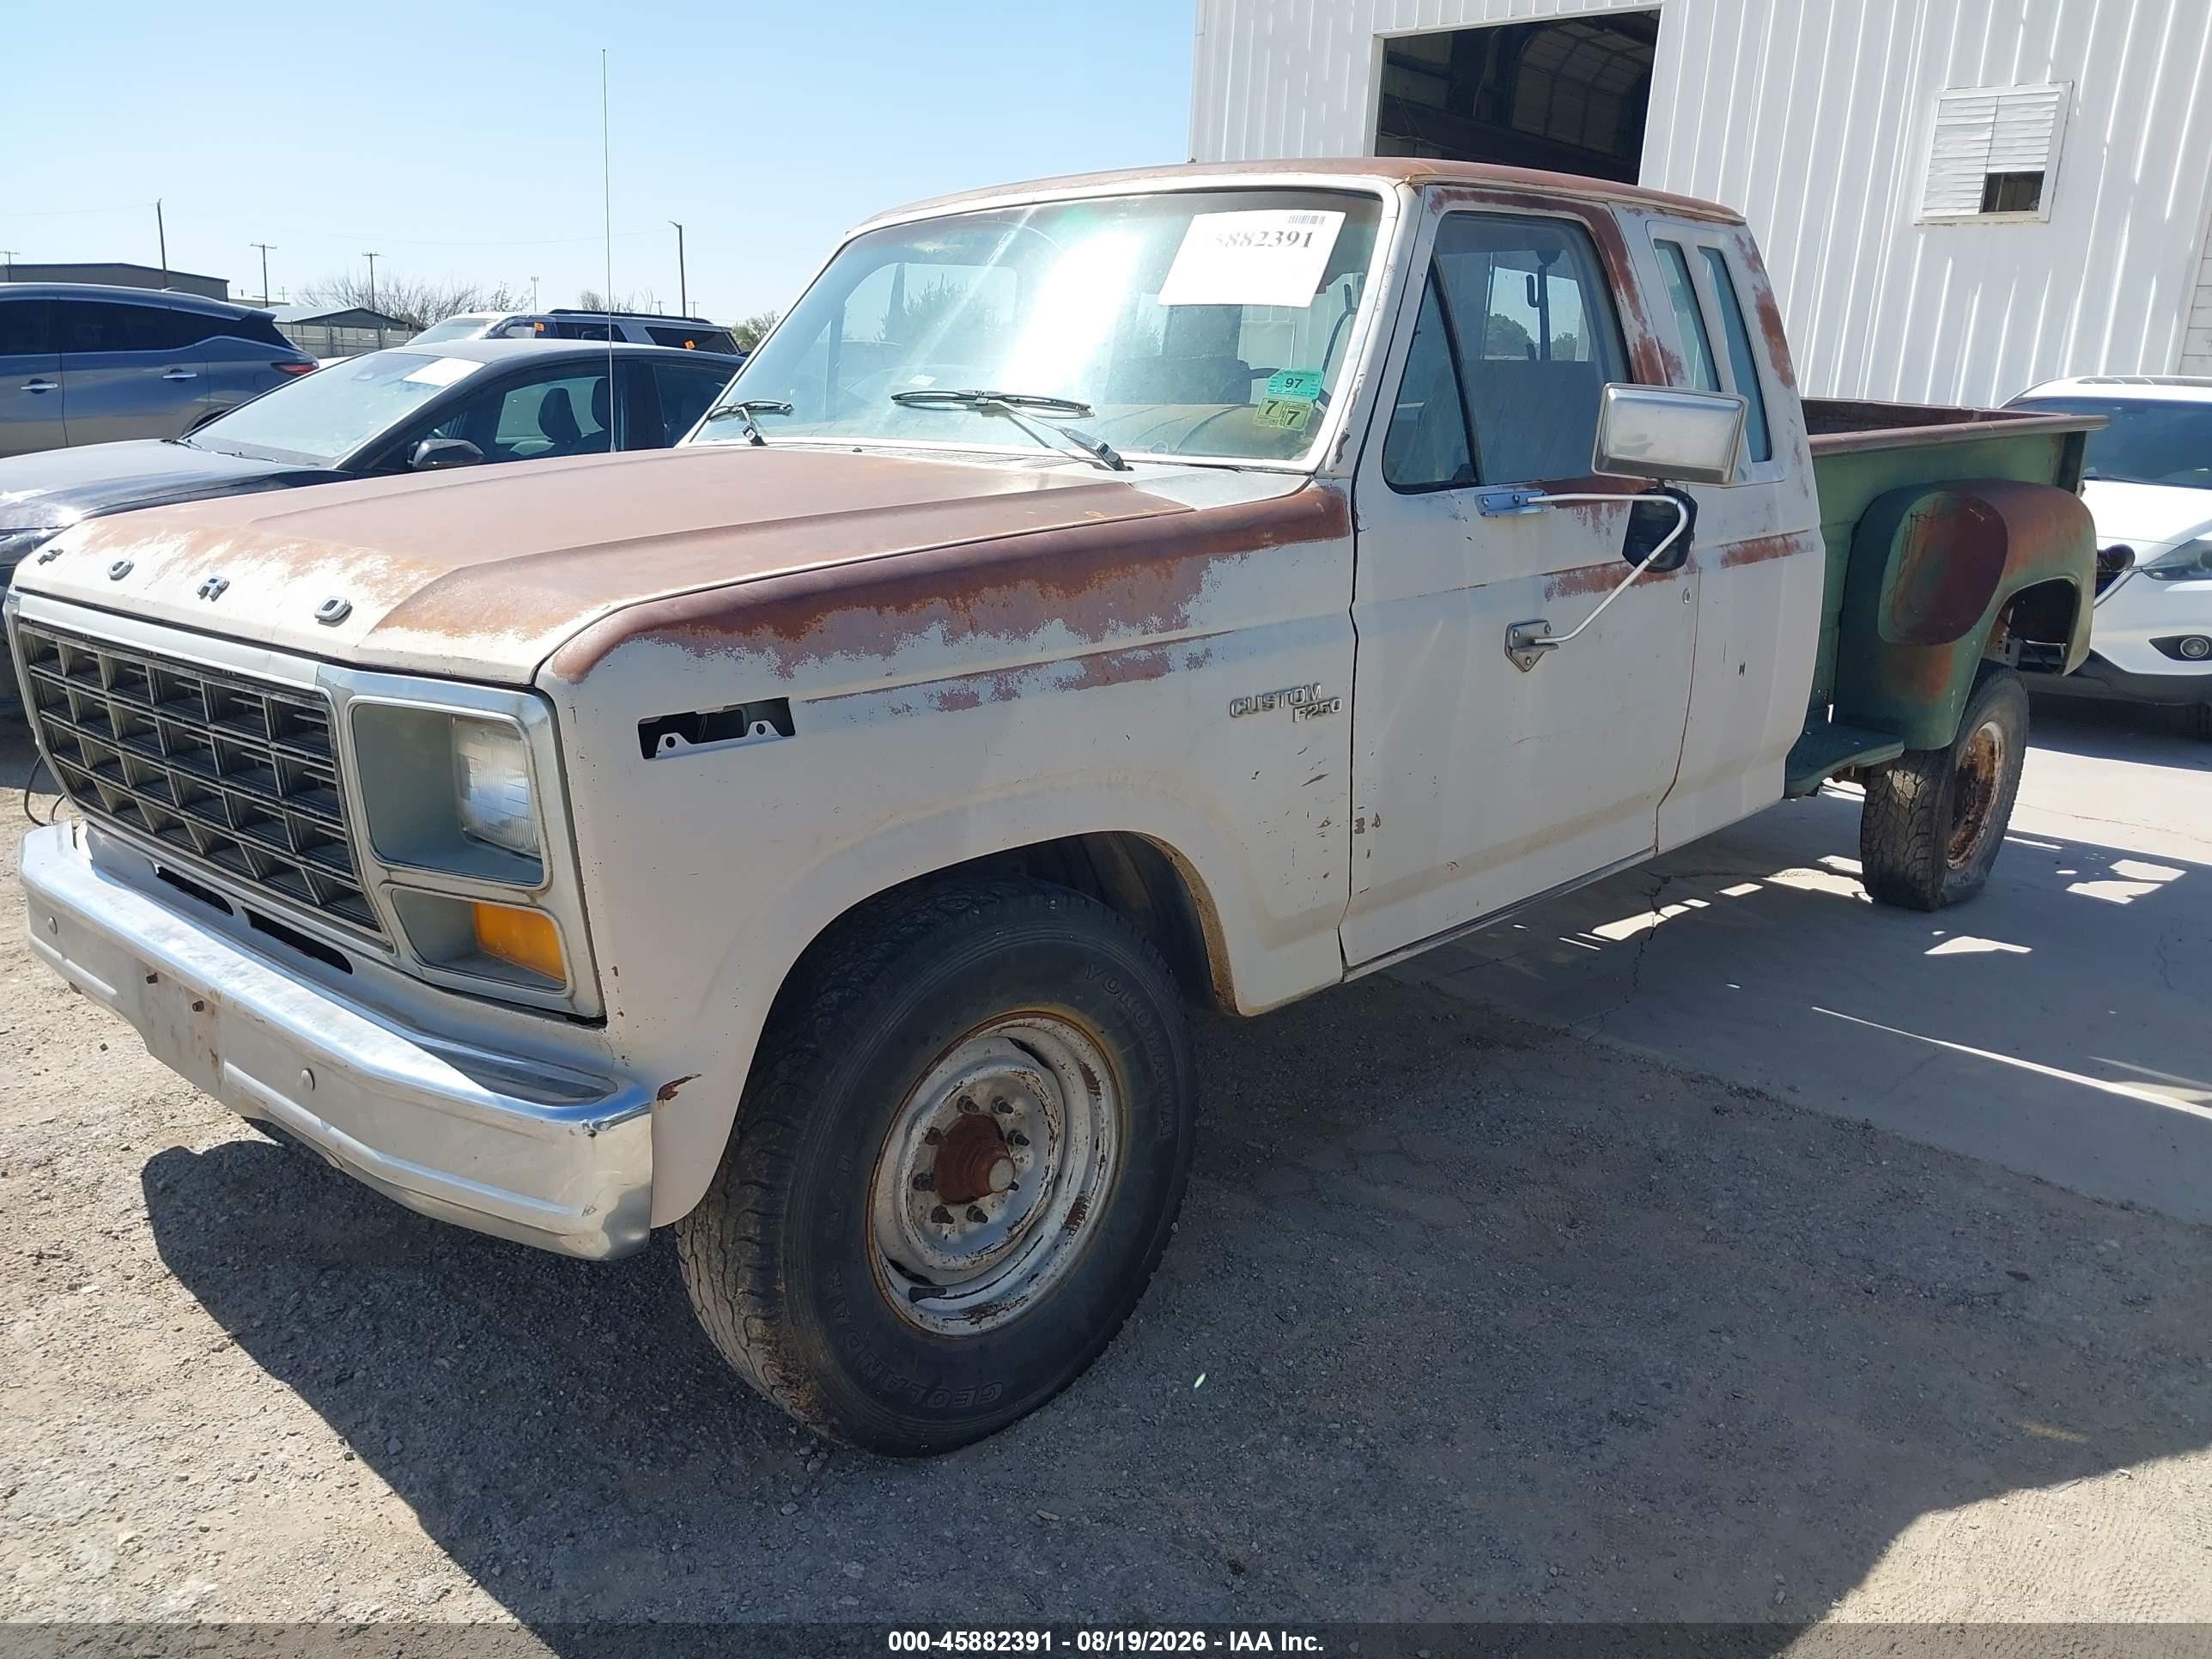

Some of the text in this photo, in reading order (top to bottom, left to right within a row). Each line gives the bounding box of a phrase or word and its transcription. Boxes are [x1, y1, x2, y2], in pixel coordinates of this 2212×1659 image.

[1285, 377, 1304, 389] 97
[1265, 400, 1279, 415] 7
[1286, 410, 1300, 426] 7
[1230, 683, 1322, 718] CUSTOM
[1293, 697, 1342, 722] F250
[1085, 961, 1176, 1138] YOKOHAMA
